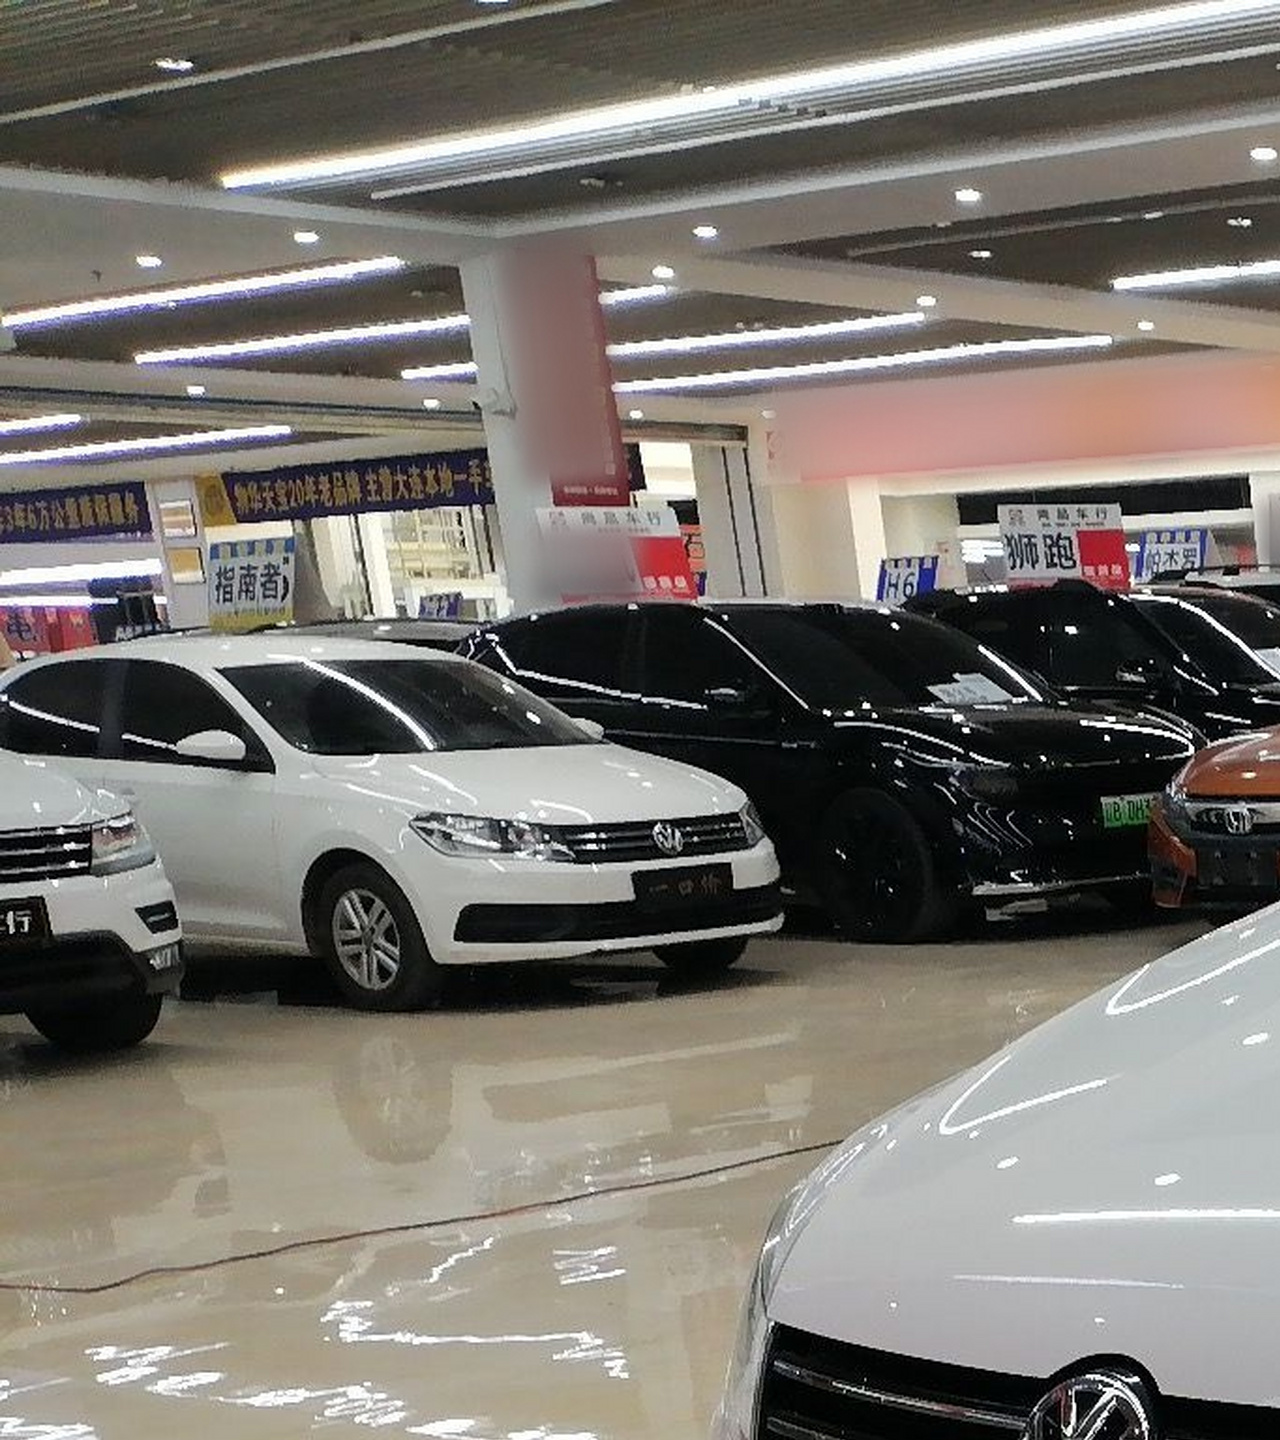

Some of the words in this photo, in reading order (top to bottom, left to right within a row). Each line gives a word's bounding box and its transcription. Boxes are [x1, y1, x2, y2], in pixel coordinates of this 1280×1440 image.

[1004, 532, 1077, 570] 狮跑
[215, 562, 282, 605] 指南者
[886, 572, 916, 600] H6
